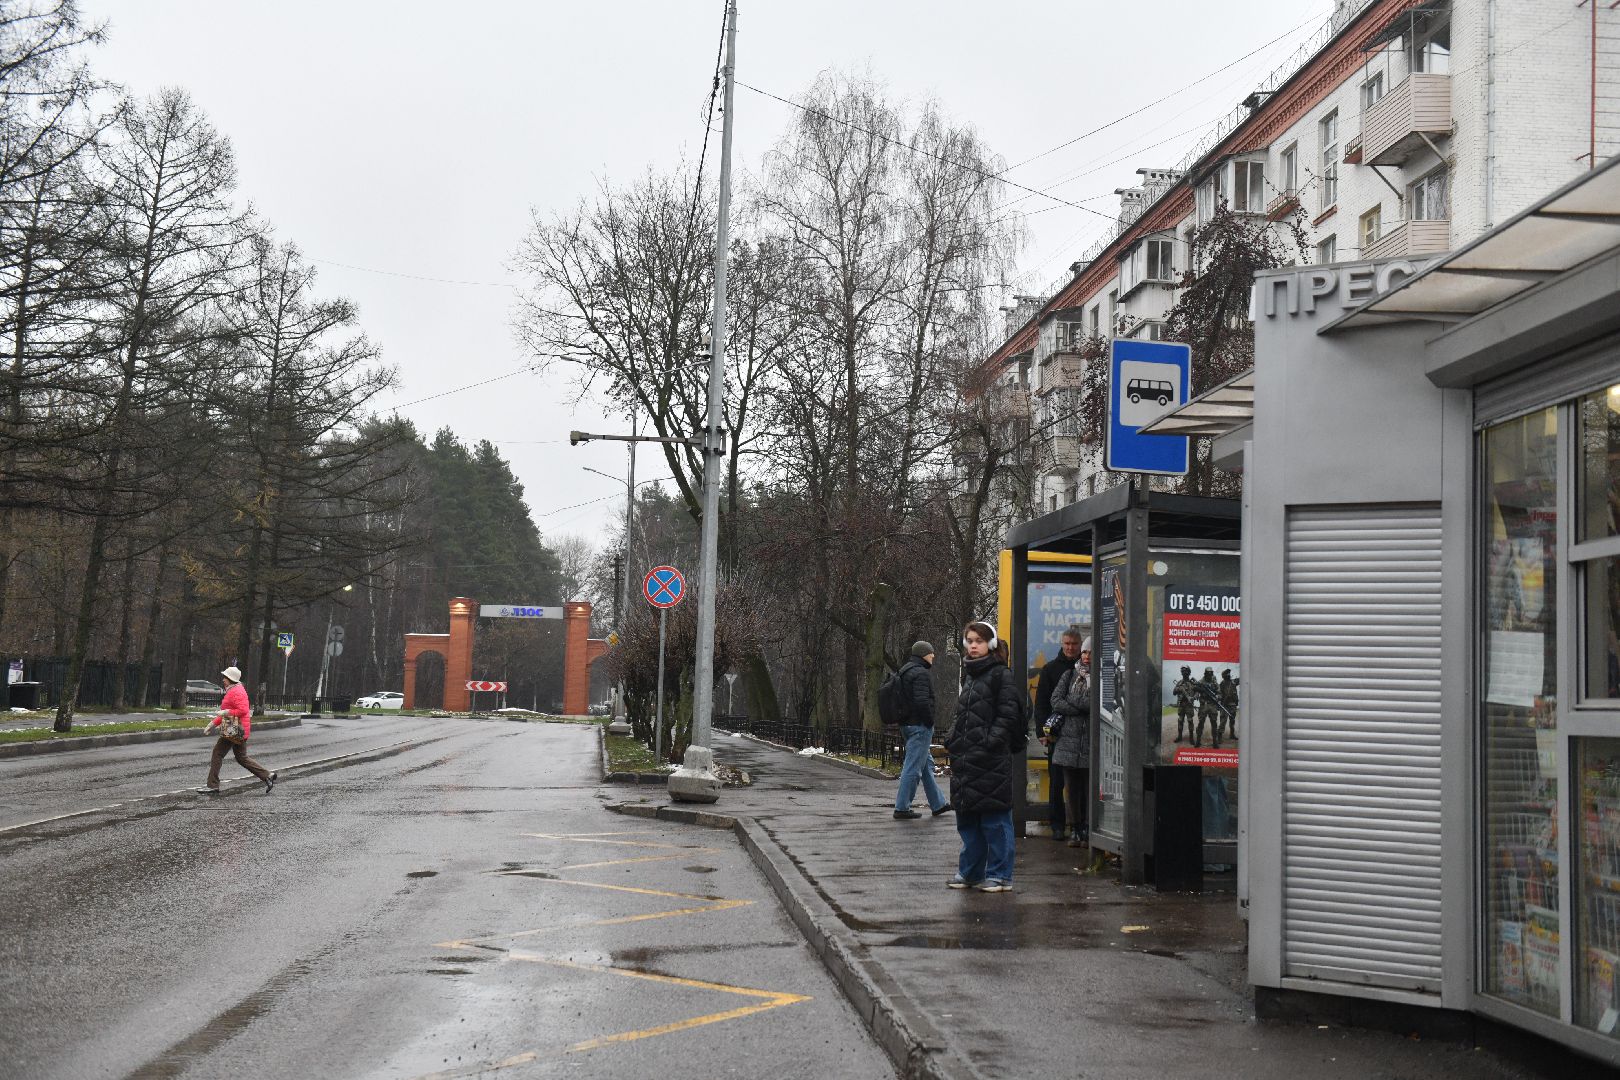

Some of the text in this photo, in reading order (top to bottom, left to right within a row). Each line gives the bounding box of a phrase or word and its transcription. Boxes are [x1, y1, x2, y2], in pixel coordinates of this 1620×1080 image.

[1264, 257, 1441, 317] ПРЕС
[1170, 594, 1184, 610] ОТ
[1187, 595, 1194, 610] 5
[1196, 595, 1219, 611] 450
[511, 607, 544, 617] ЛЗОС
[1169, 619, 1210, 628] ПОЛАГАЕТСЯ
[1169, 629, 1220, 637] КОНТРАКТНИКУ
[1169, 638, 1219, 648] ЗА ПЕРВЫЙ ГОД
